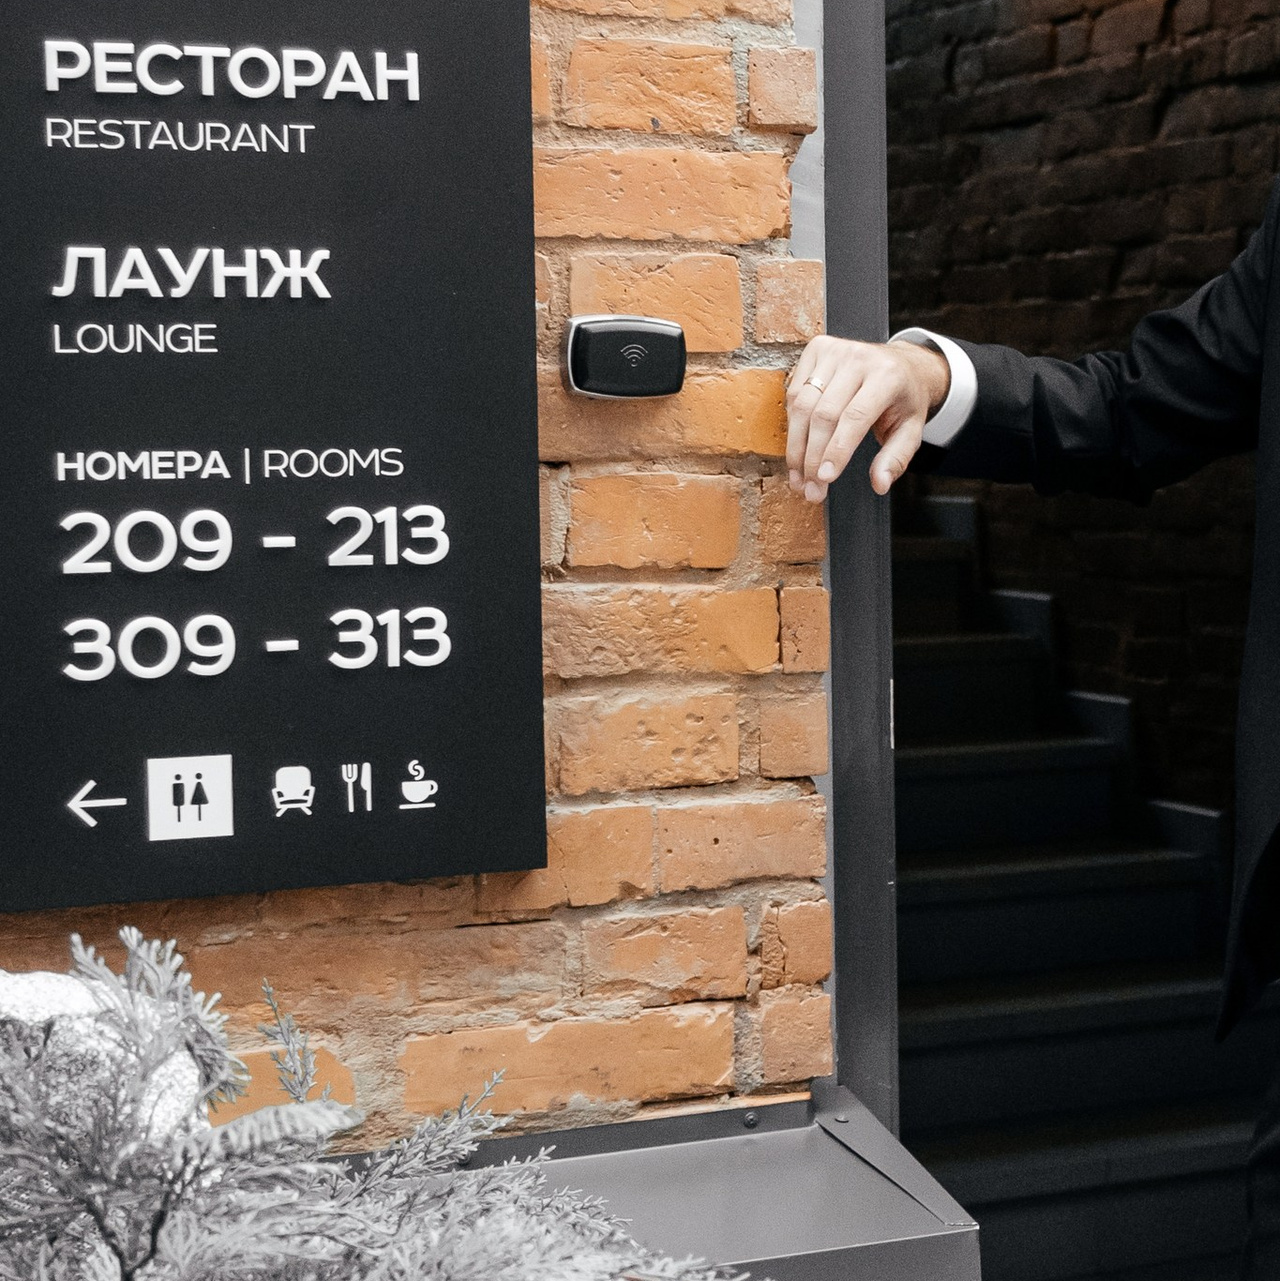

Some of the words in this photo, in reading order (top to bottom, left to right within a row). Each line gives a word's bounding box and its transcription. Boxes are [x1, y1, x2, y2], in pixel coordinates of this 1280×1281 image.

[43, 38, 420, 101] РЕСТОРАН
[46, 118, 315, 153] RESTAURANT
[52, 246, 331, 299] ЛАУНЖ
[54, 324, 218, 353] LOUNGE
[57, 450, 231, 481] НОМЕРА
[263, 448, 404, 478] ROOMS
[60, 508, 232, 574] 209
[326, 505, 449, 571] 213
[63, 613, 235, 681] 309
[328, 606, 451, 669] 313
